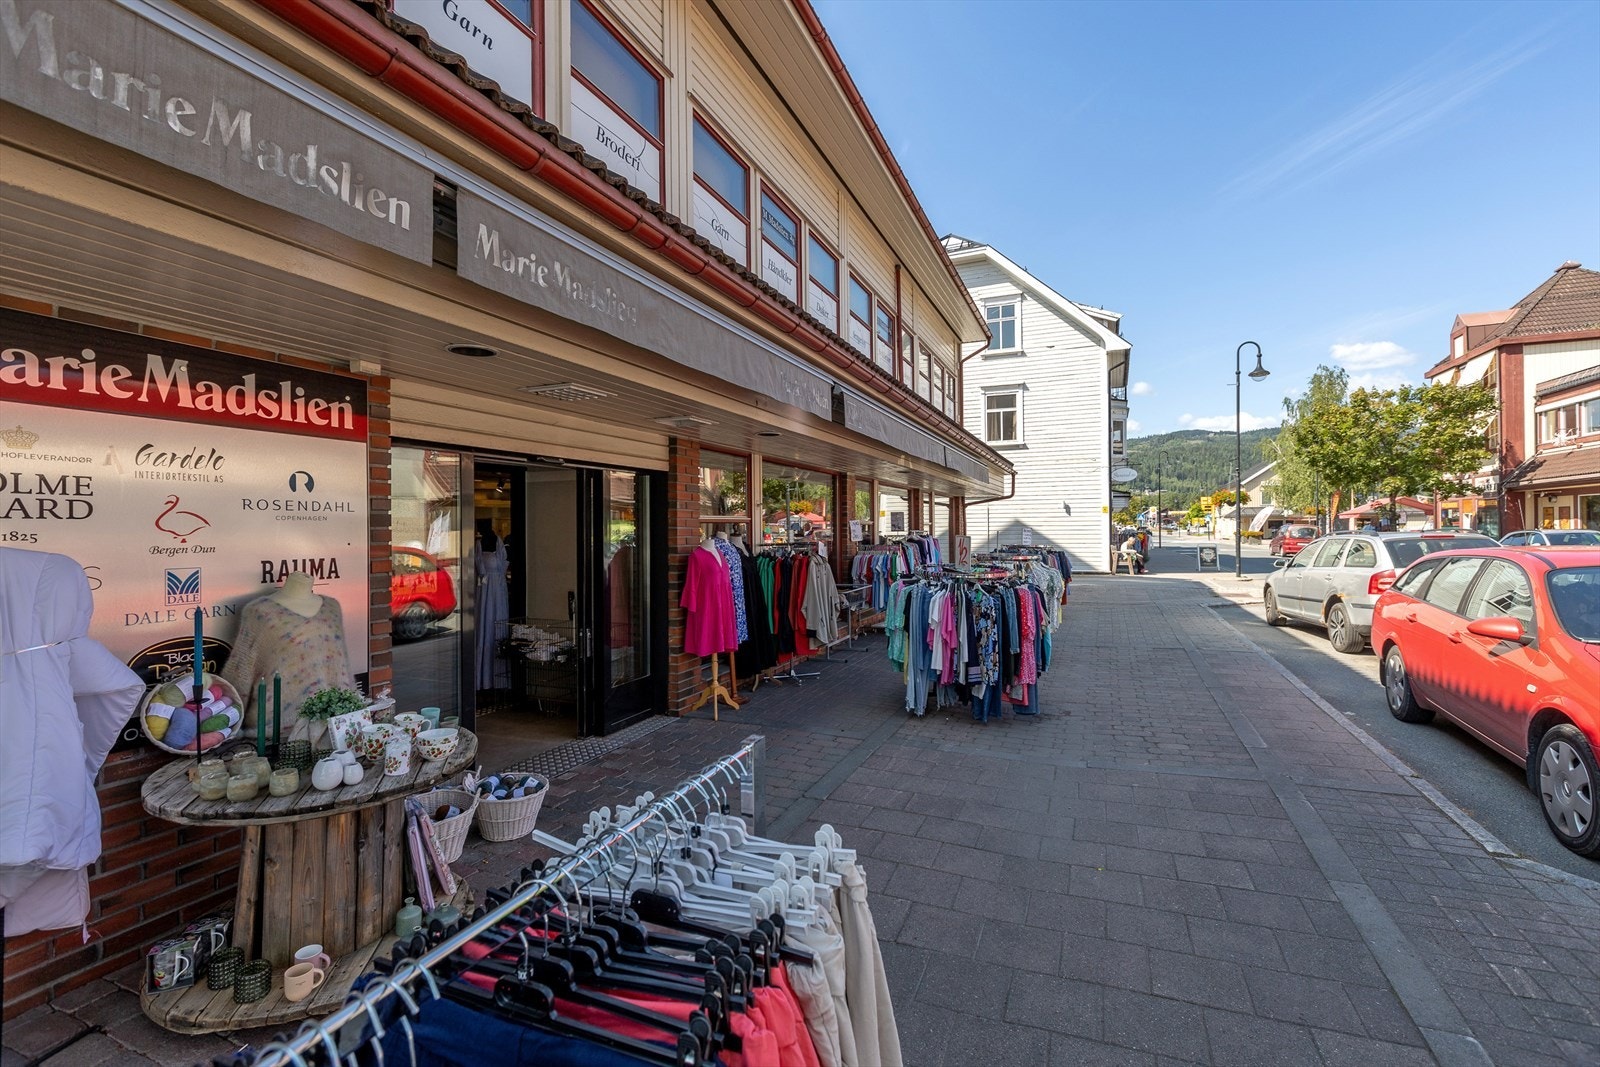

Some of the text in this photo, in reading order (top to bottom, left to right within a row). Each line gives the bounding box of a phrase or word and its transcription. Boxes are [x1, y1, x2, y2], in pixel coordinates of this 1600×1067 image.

[443, 0, 494, 50] Garn
[596, 125, 641, 171] Broderi
[711, 217, 730, 242] Garn
[1, 452, 93, 464] HOFLEVERANDØR
[135, 443, 226, 471] Gardelo
[134, 470, 224, 483] INTERIØRTEKSTIL AS
[241, 498, 356, 513] ROSENDAHL
[1, 530, 39, 544] 1825
[149, 544, 216, 557] Bergen Dun
[167, 594, 200, 605] DALE
[124, 609, 178, 627] DALE
